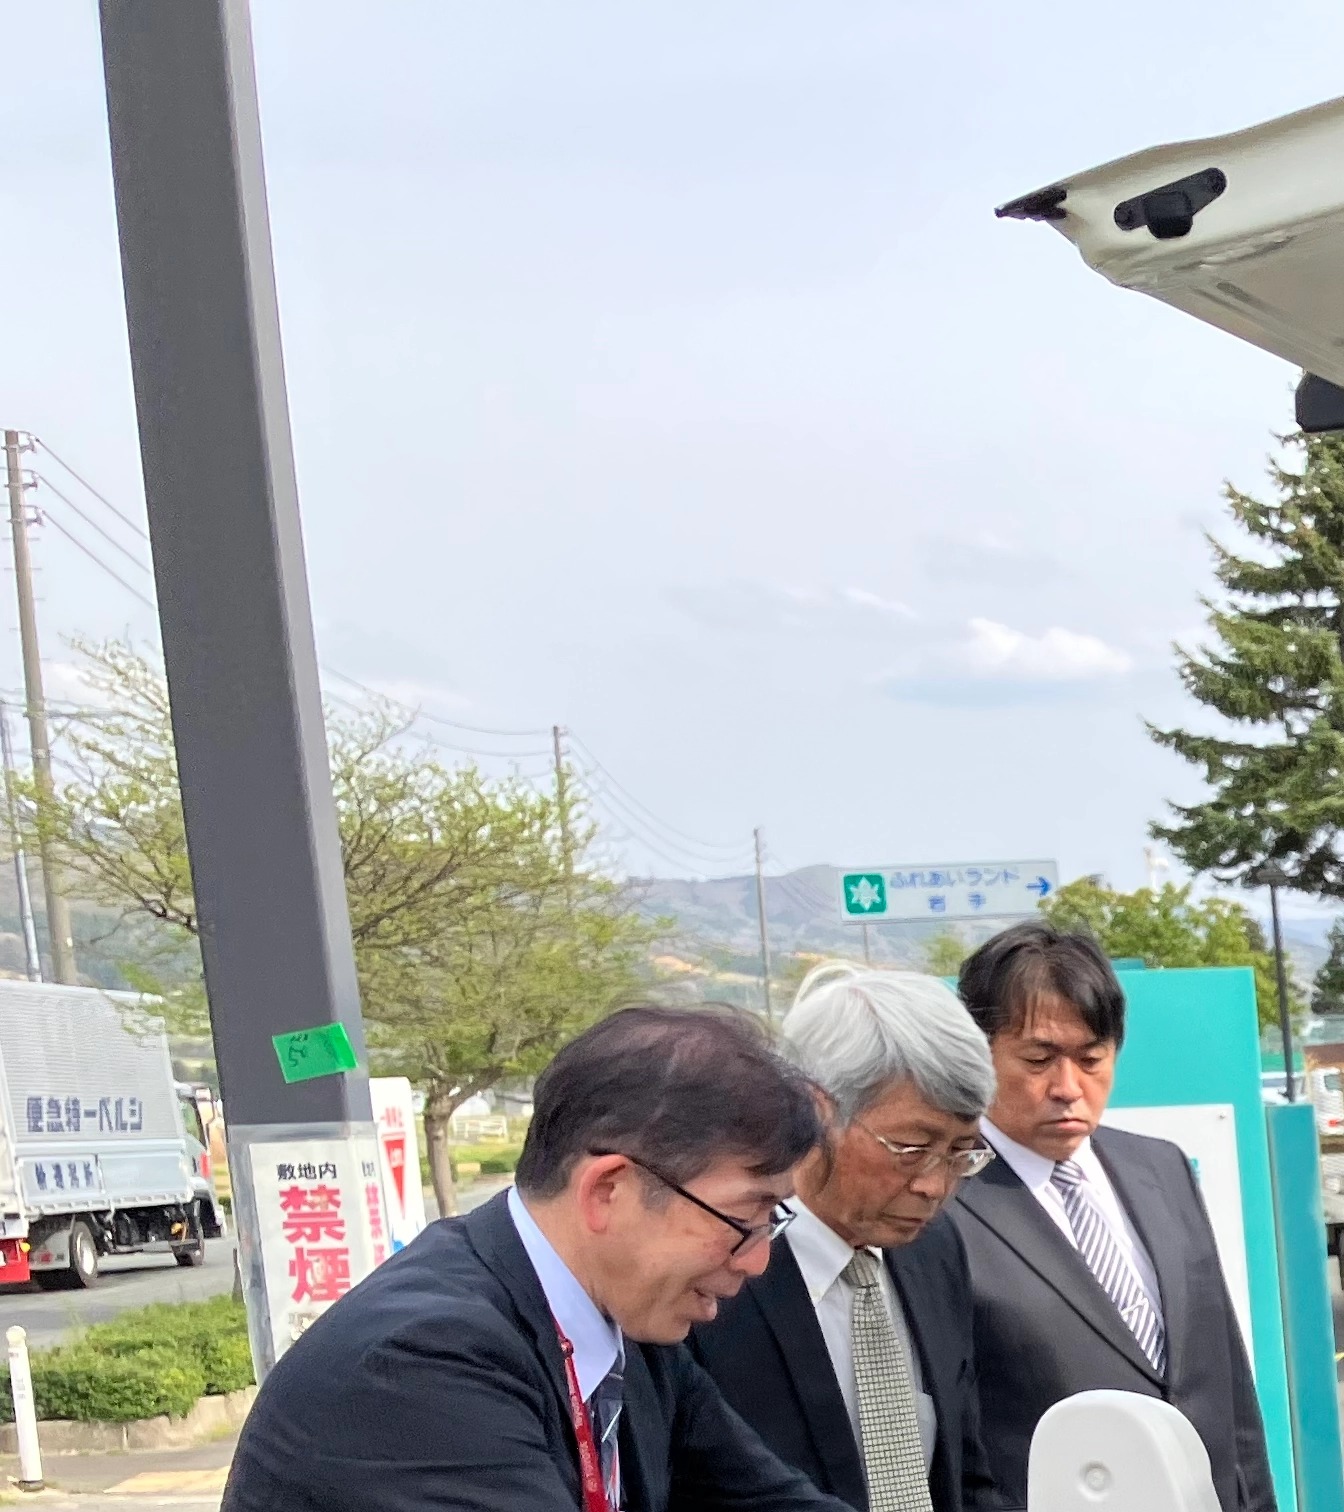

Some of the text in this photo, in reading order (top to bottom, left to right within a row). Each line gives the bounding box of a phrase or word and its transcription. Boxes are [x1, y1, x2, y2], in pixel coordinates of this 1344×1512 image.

[276, 1162, 337, 1181] 敷地内
[278, 1184, 350, 1303] 禁煙
